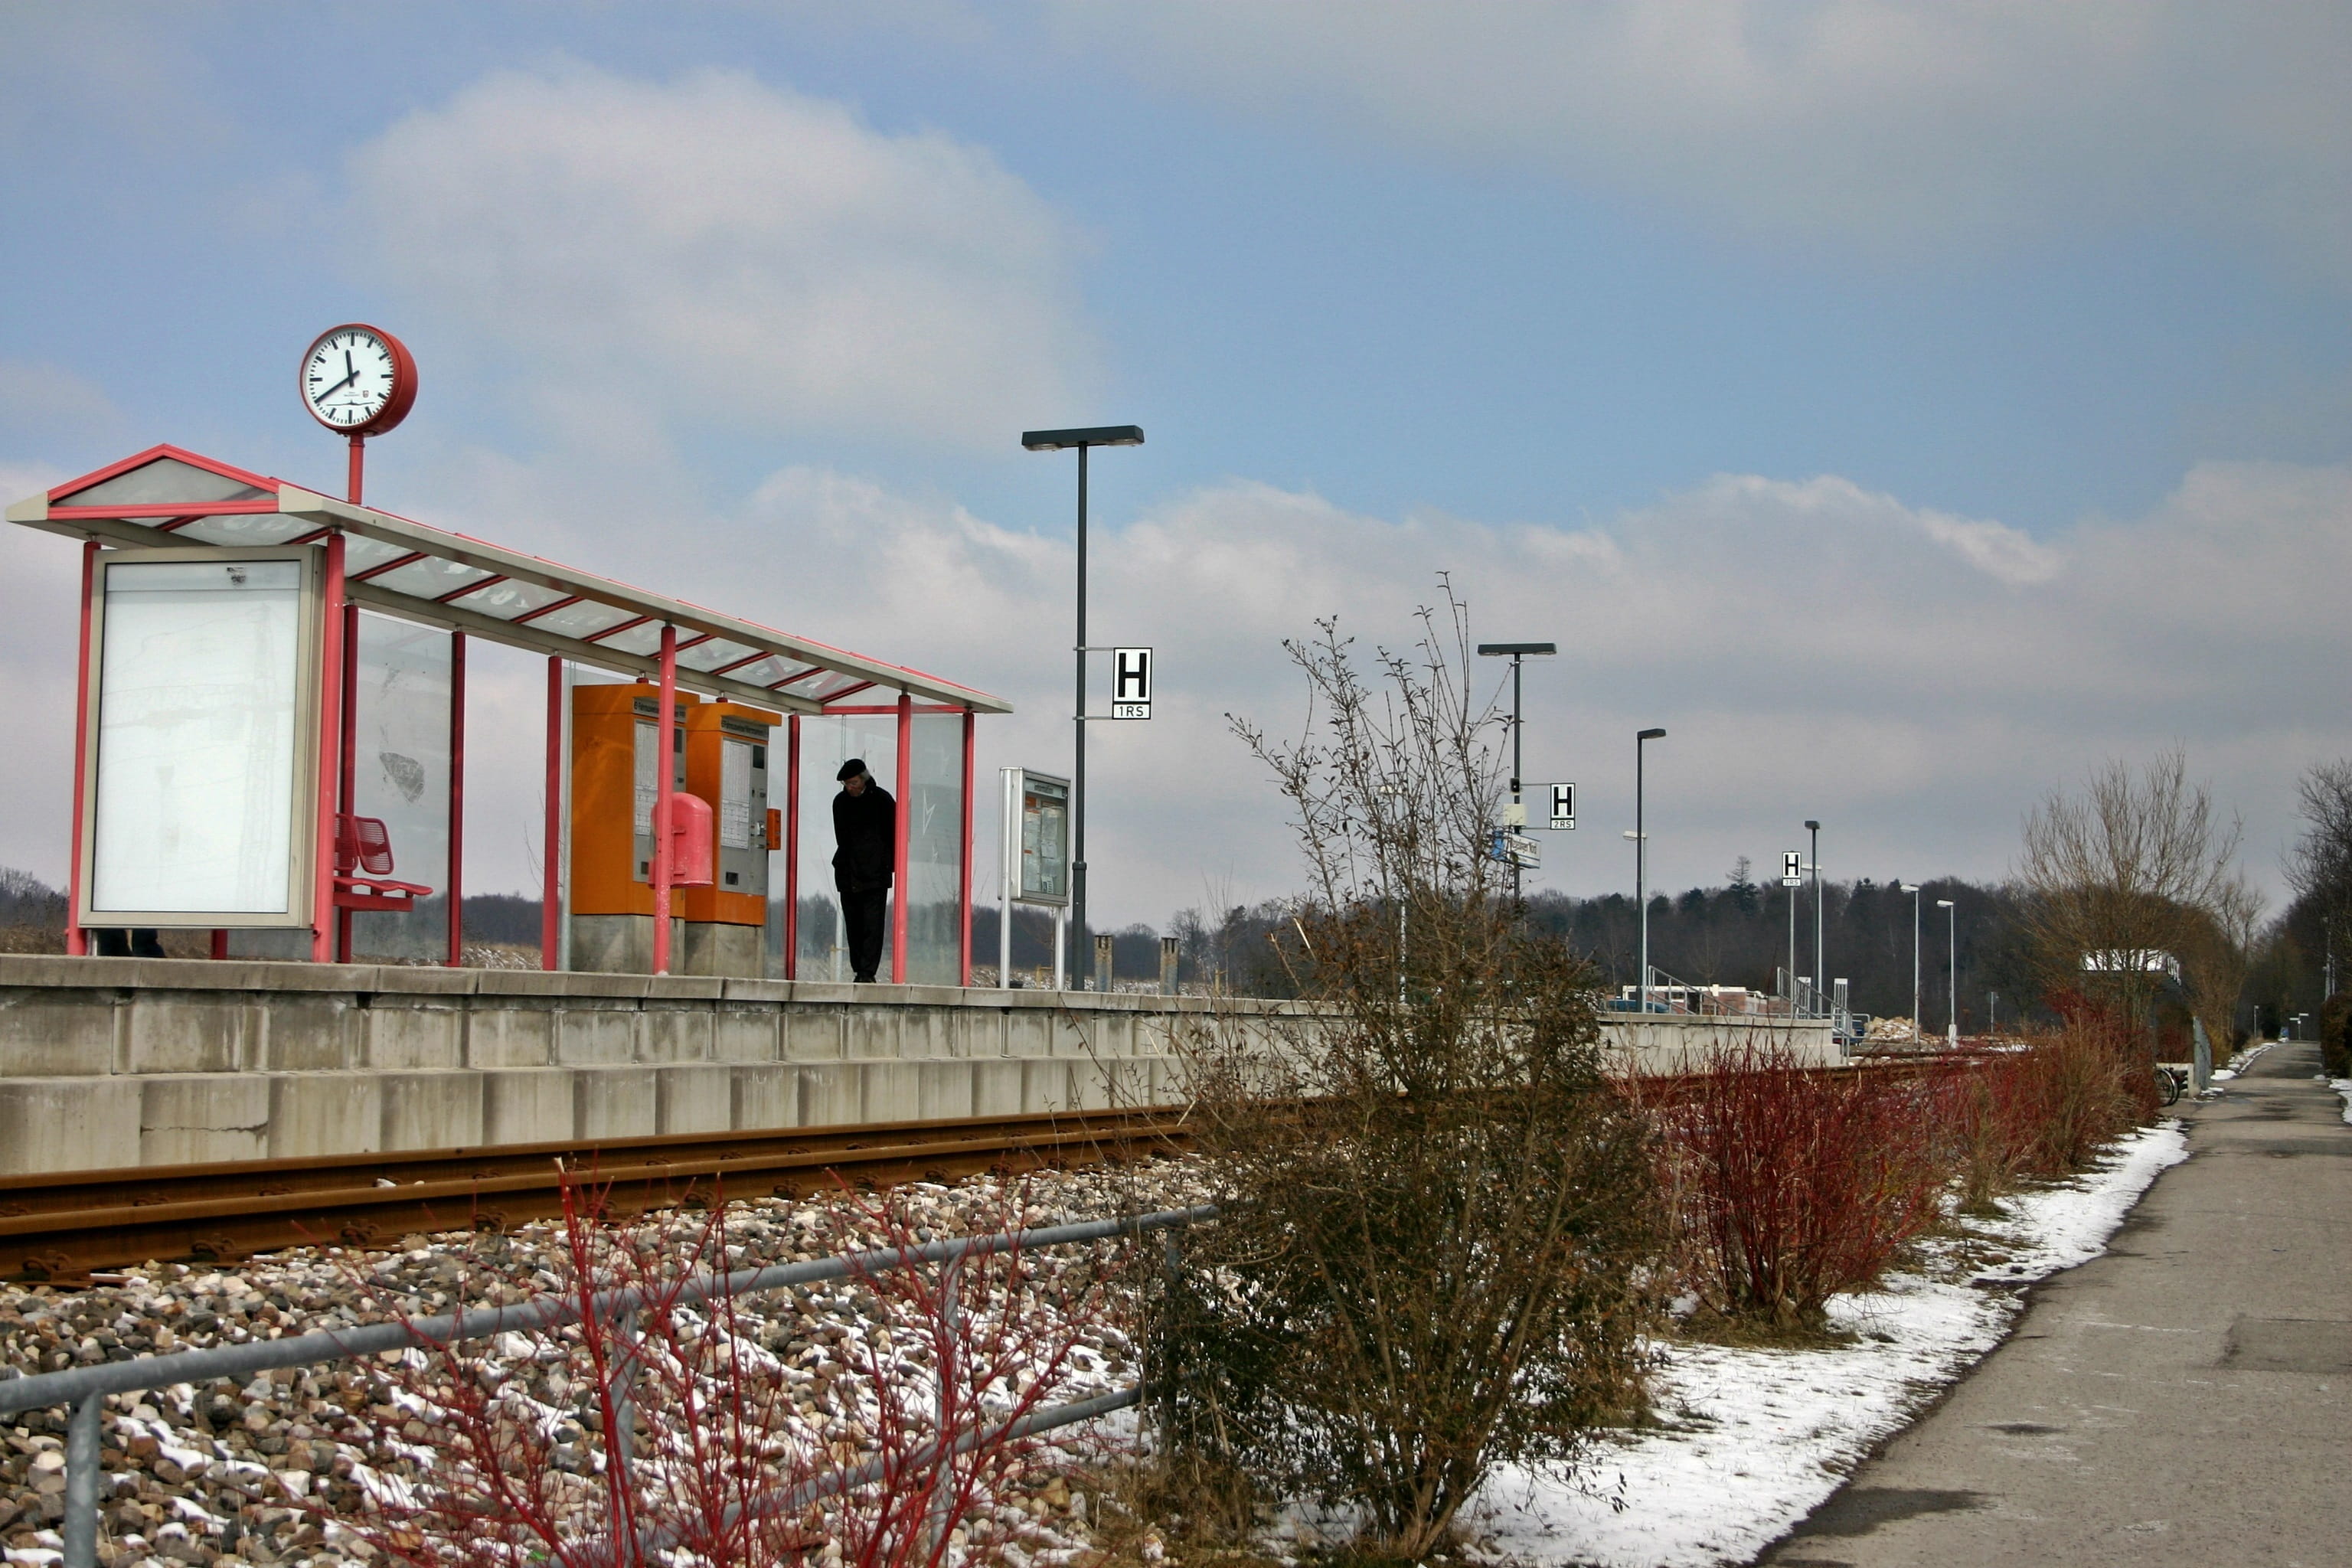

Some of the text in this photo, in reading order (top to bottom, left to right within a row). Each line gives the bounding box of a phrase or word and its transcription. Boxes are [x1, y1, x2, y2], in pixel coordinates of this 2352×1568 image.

[1118, 652, 1147, 697] H
[1119, 706, 1144, 717] 1RS
[1553, 786, 1572, 815] H
[1554, 820, 1572, 828] 2RS
[1785, 854, 1798, 876] H
